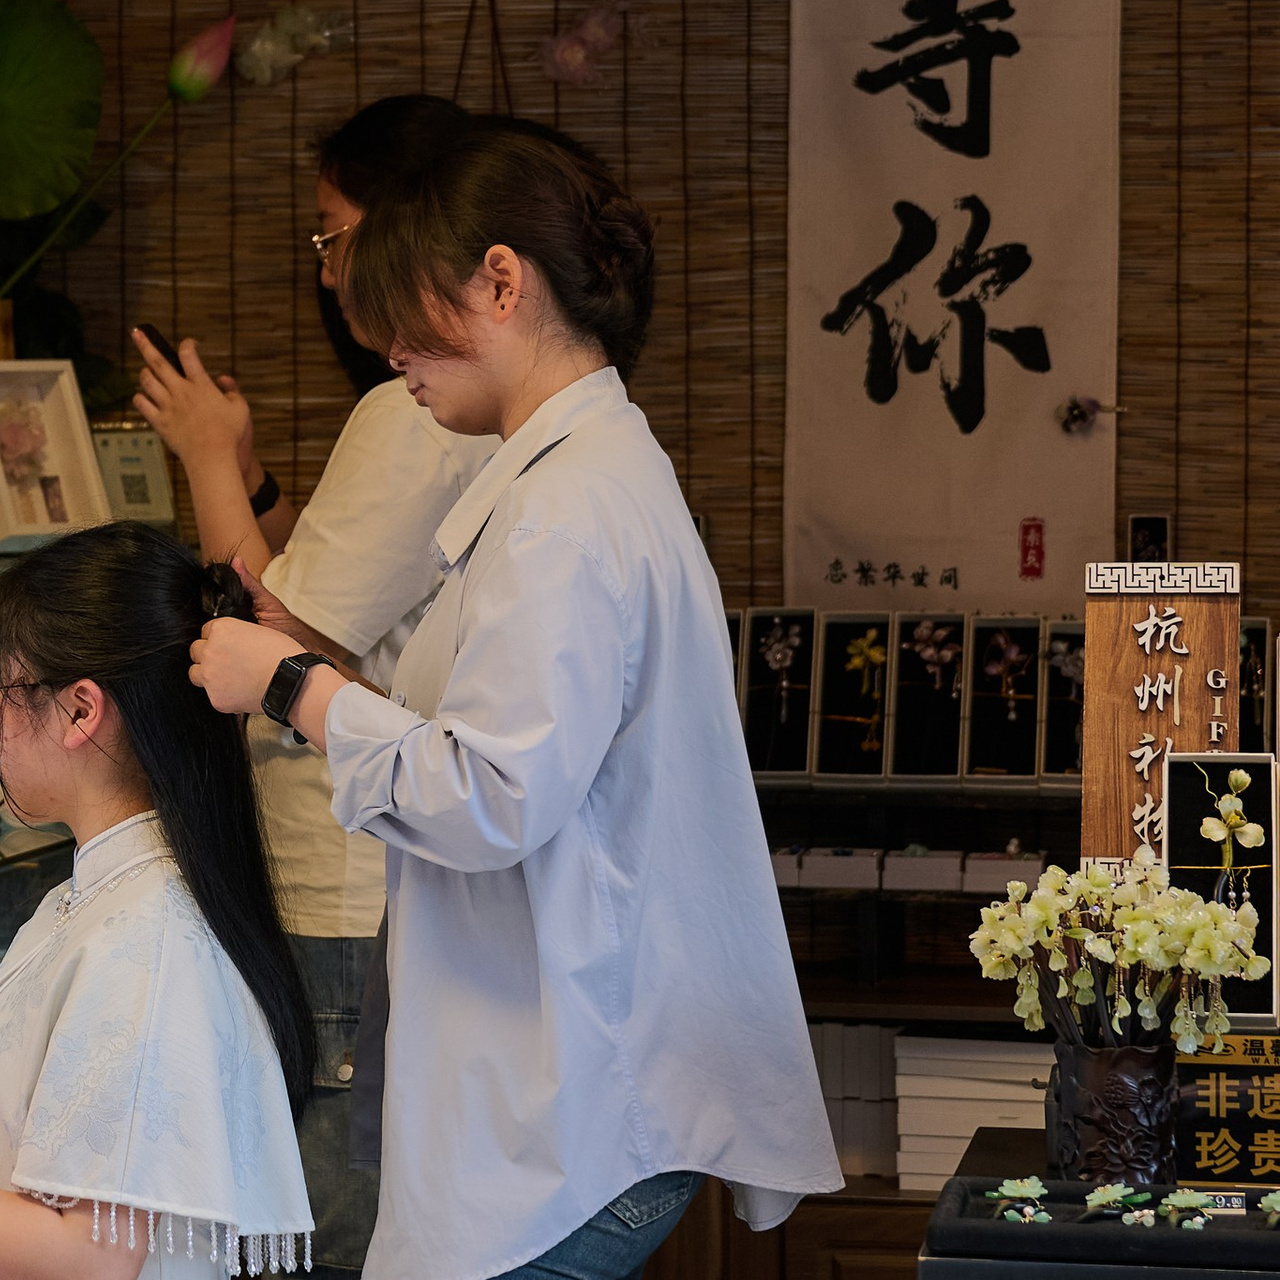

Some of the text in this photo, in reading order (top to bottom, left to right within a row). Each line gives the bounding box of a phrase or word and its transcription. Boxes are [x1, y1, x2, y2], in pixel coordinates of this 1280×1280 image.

[1205, 668, 1229, 754] GIF
[1195, 1072, 1280, 1120] 非遗
[1195, 1127, 1280, 1177] 珍贵
